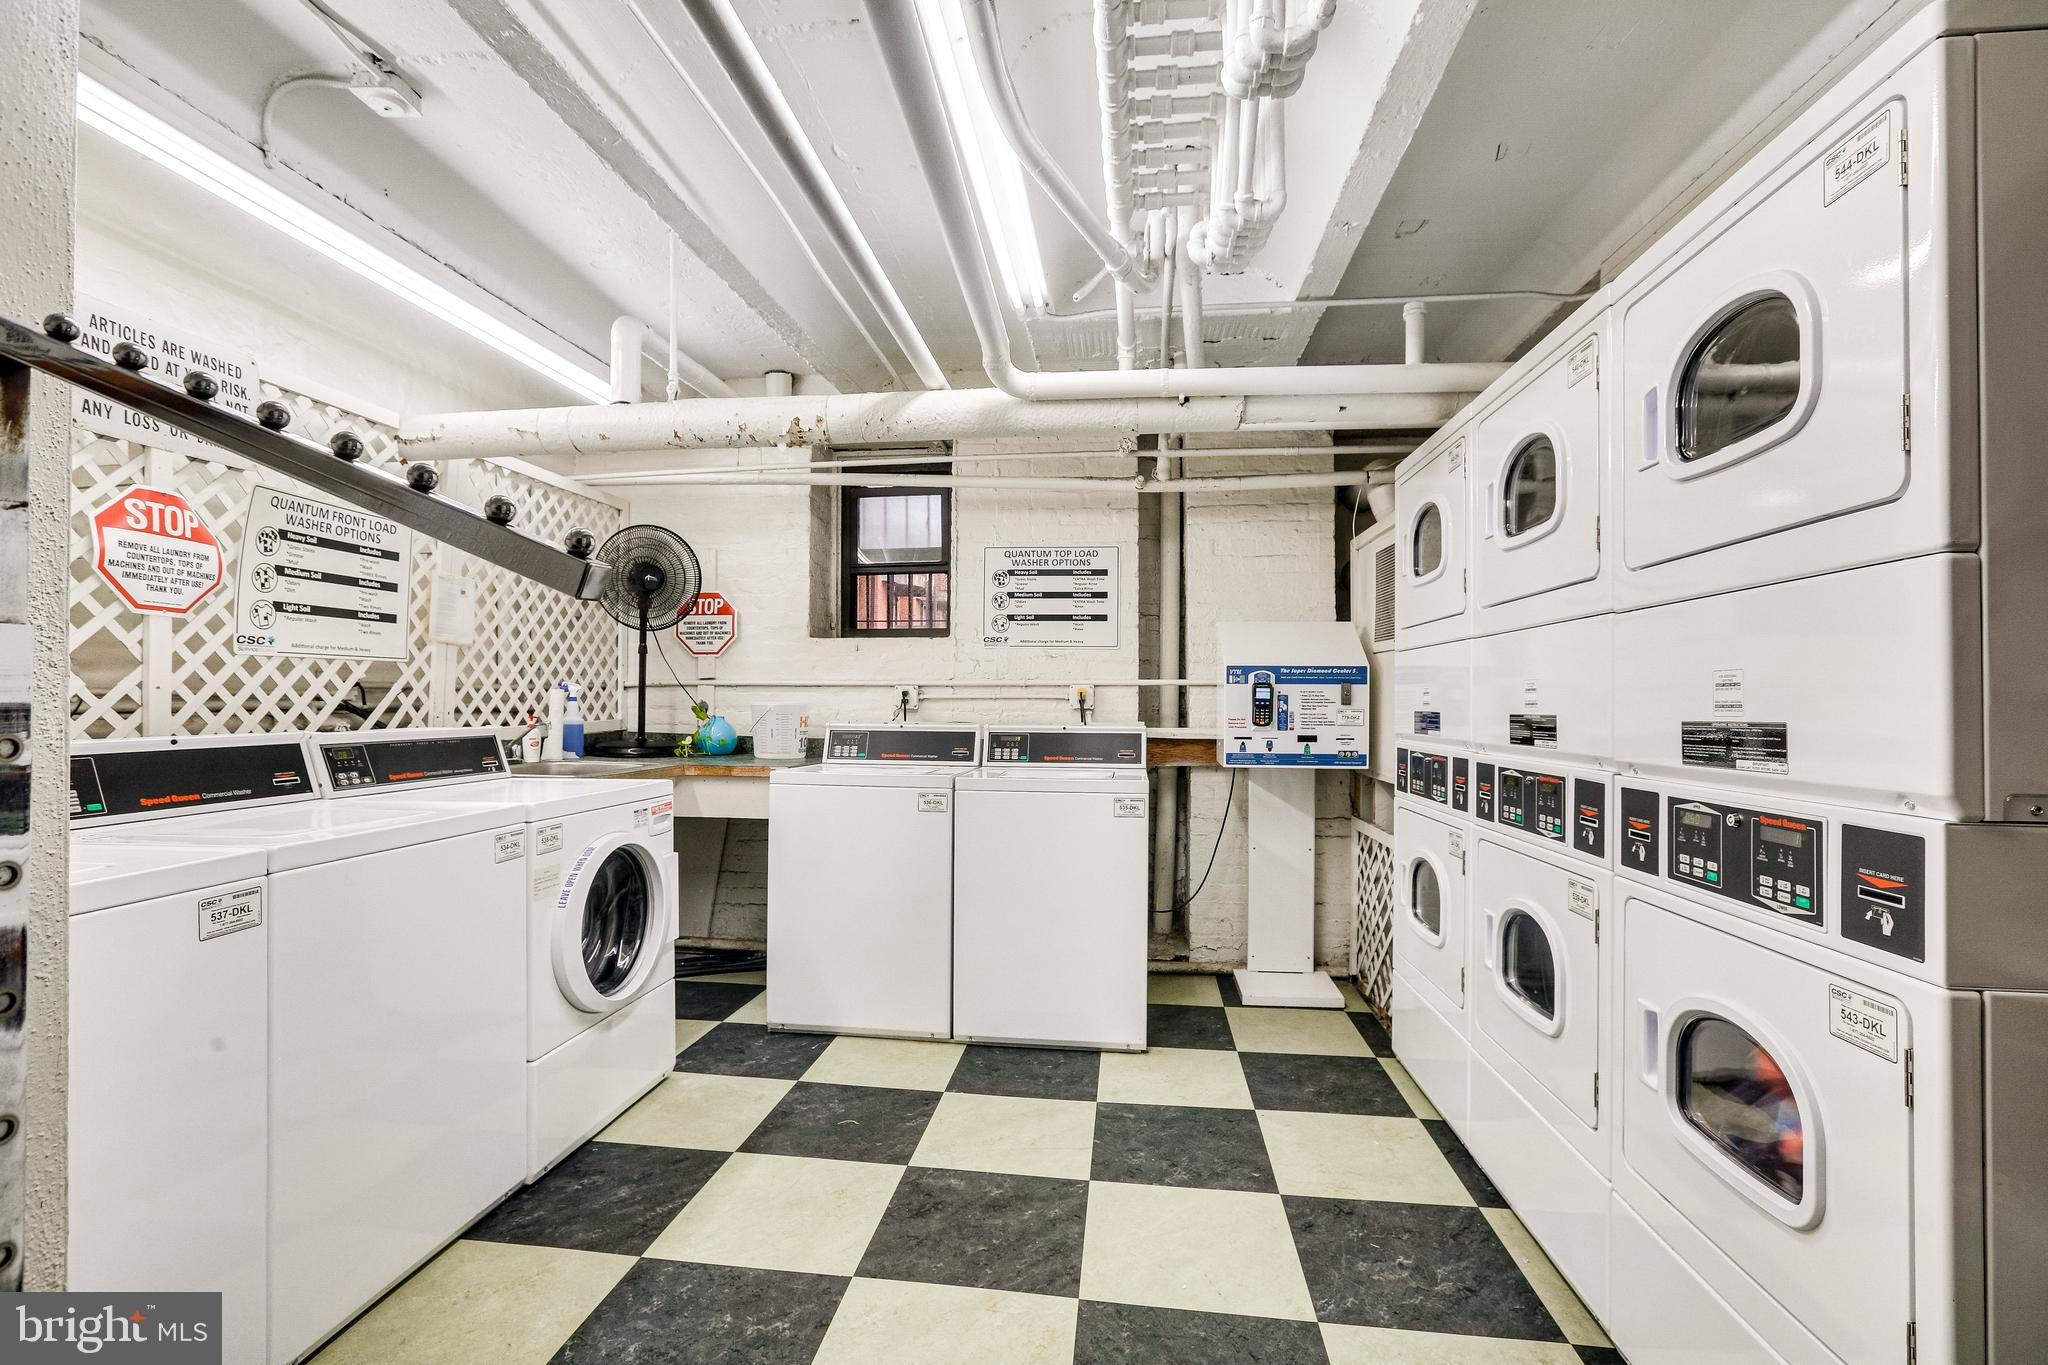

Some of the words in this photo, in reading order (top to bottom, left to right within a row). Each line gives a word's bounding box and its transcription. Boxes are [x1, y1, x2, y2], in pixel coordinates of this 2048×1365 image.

[1835, 140, 1880, 180] 544-DKL
[89, 314, 155, 350] ARTICLES
[162, 340, 185, 360] ARE
[191, 349, 242, 379] WASHED
[81, 333, 110, 354] AND
[165, 362, 180, 378] AT
[221, 380, 251, 401] RISK.
[82, 399, 112, 419] ANY
[124, 410, 160, 432] LOSS
[124, 498, 199, 538] STOP
[271, 495, 329, 520] QUANTUM
[332, 511, 366, 529] FRONT
[369, 520, 397, 535] LOAD
[286, 514, 332, 534] WASHER
[335, 525, 381, 544] OPTIONS
[287, 531, 305, 543] Heavy
[306, 535, 318, 544] Soil
[118, 540, 147, 552] REMOVE
[149, 546, 160, 554] ALL
[162, 547, 191, 559] LAUNDRY
[193, 553, 210, 561] FROM
[360, 546, 382, 556] Includes
[1004, 550, 1051, 559] QUANTUM
[1054, 550, 1072, 558] TOP
[1074, 550, 1099, 558] LOAD
[126, 552, 176, 566] COUNTERTOPS,
[178, 560, 194, 569] TOPS
[195, 562, 203, 570] OF
[1011, 559, 1049, 567] WASHER
[1051, 559, 1091, 567] OPTIONS
[108, 559, 145, 571] MACHINES
[147, 564, 160, 573] AND
[162, 567, 175, 575] OUT
[186, 570, 216, 581] MACHINES
[284, 567, 310, 578] Medium
[310, 571, 322, 580] Soil
[122, 571, 169, 584] IMMEDIATELY
[170, 578, 190, 586] AFTER
[359, 578, 381, 588] Includes
[146, 584, 168, 593] THANK
[283, 603, 299, 613] Light
[299, 604, 311, 613] Soil
[358, 611, 380, 620] Includes
[236, 634, 266, 645] CSC
[140, 796, 171, 807] Speed
[172, 793, 201, 803] Queen
[201, 789, 233, 800] Commercial
[233, 788, 252, 796] Washer
[1759, 815, 1783, 827] Speed
[1783, 819, 1807, 831] Queen
[564, 872, 578, 888] OPEN
[1859, 867, 1876, 877] INSERT
[1876, 871, 1890, 879] CARD
[1890, 874, 1905, 883] HERE
[201, 899, 217, 908] CSC
[558, 889, 571, 909] LEAVE
[211, 904, 253, 922] 537-DKL
[1831, 988, 1847, 999] CSC
[1840, 1008, 1886, 1037] 543-DKL
